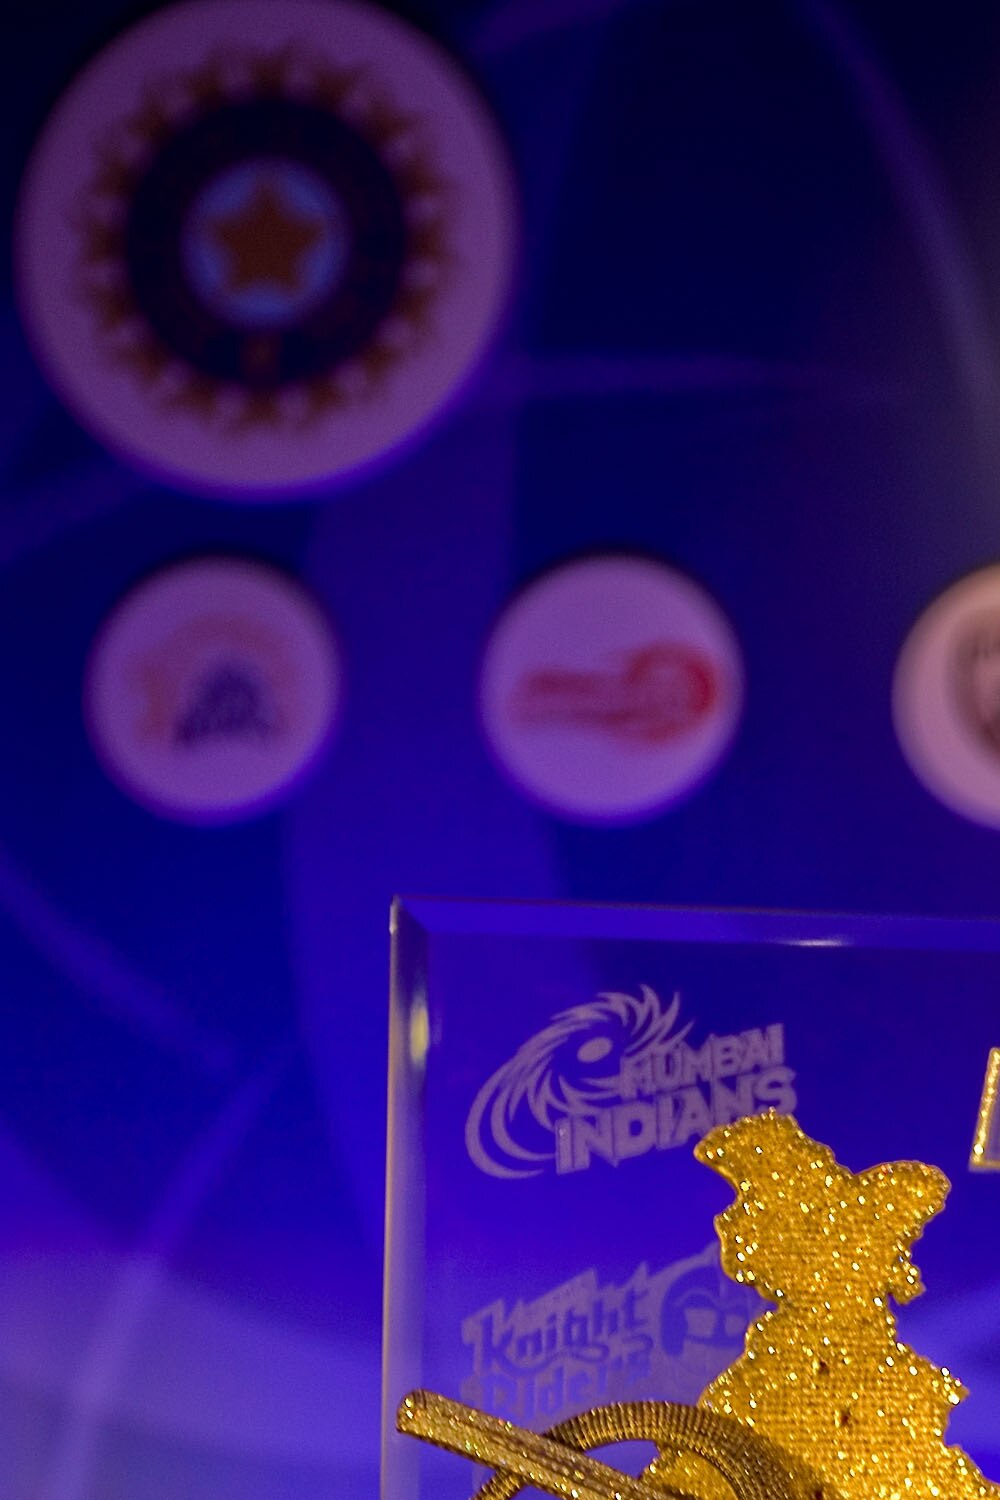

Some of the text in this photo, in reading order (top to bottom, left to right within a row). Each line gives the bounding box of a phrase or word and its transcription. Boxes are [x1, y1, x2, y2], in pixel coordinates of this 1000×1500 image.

[620, 1023, 785, 1101] MUMBAI
[555, 1066, 798, 1175] INDIANS
[480, 1287, 651, 1376] Knight
